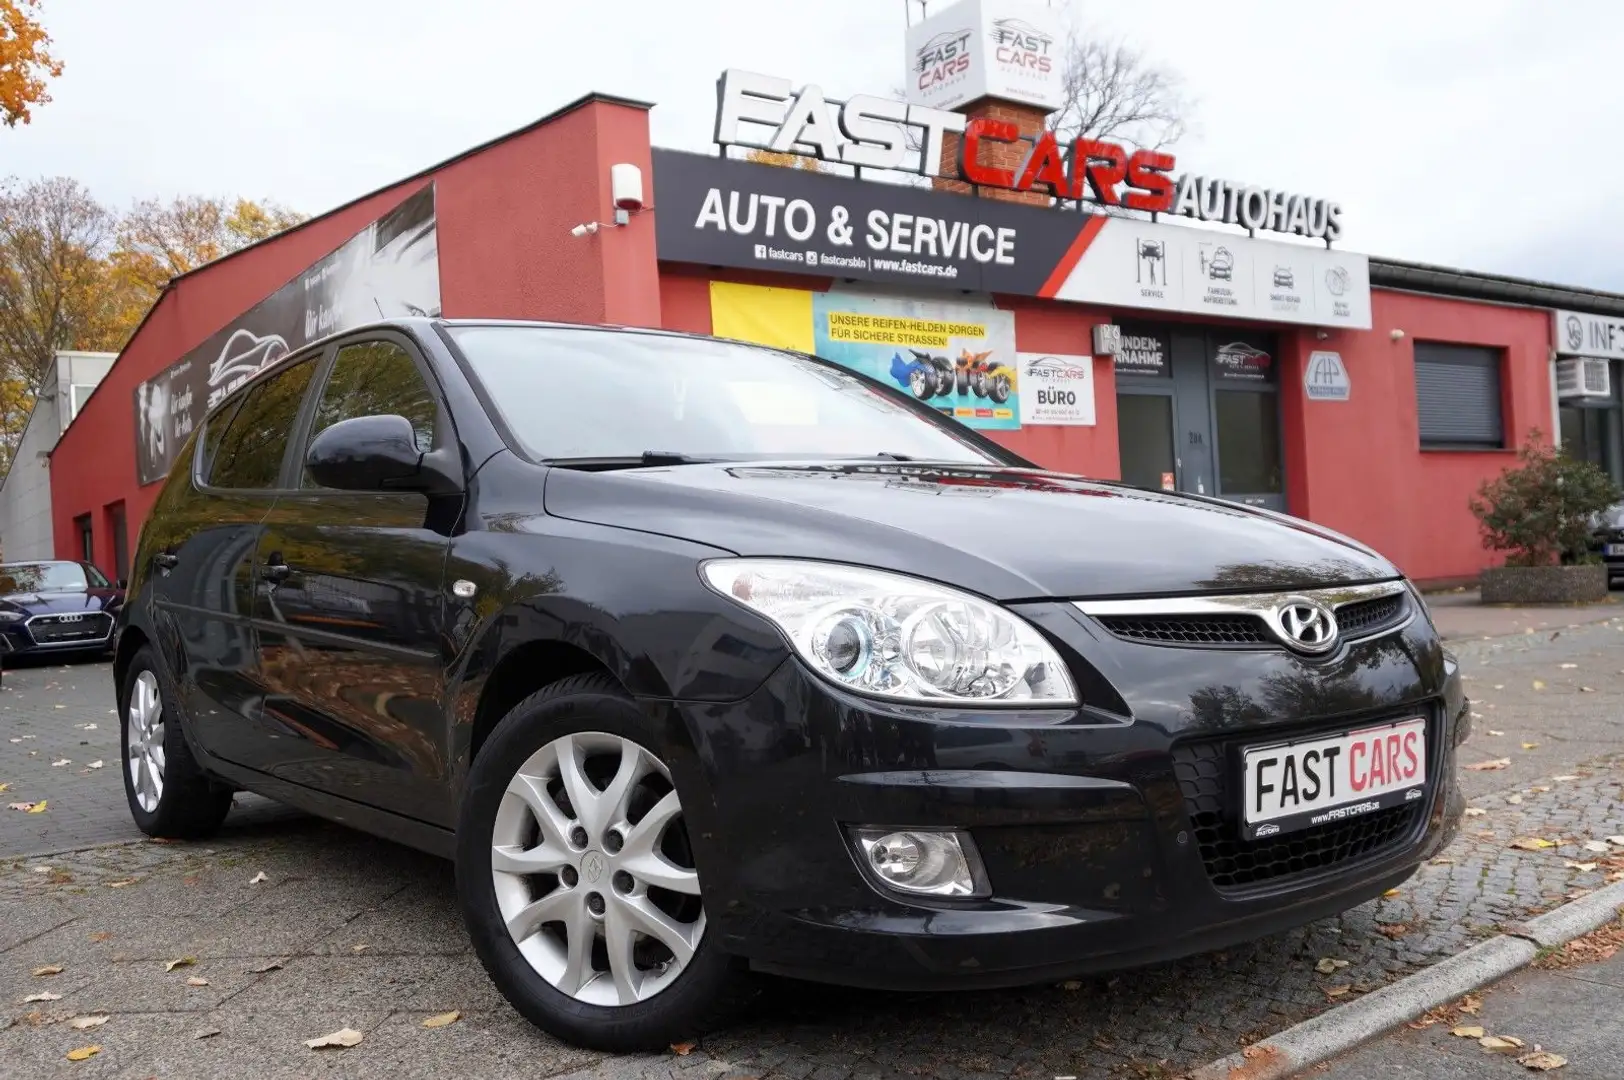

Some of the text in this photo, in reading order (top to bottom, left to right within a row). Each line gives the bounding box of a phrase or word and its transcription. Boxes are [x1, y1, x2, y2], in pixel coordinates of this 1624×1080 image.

[921, 33, 971, 72] FAST
[998, 29, 1053, 54] FAST
[918, 52, 970, 91] CARS
[996, 47, 1053, 73] CARS
[1173, 173, 1343, 241] AUTOHAUS
[694, 186, 1017, 265] AUTO & SERVICE
[768, 247, 959, 279] fastcars fastcarsbln www.fastcars.de
[830, 313, 986, 337] UNSERE REIFEN-HELDEN SORGEN
[831, 326, 948, 347] FÜR SICHERE STRASSEN!
[1117, 335, 1162, 352] UNDEN-
[1114, 349, 1163, 366] NNAHME
[1037, 385, 1076, 406] BÜRO
[1256, 730, 1419, 813] FAST CARS
